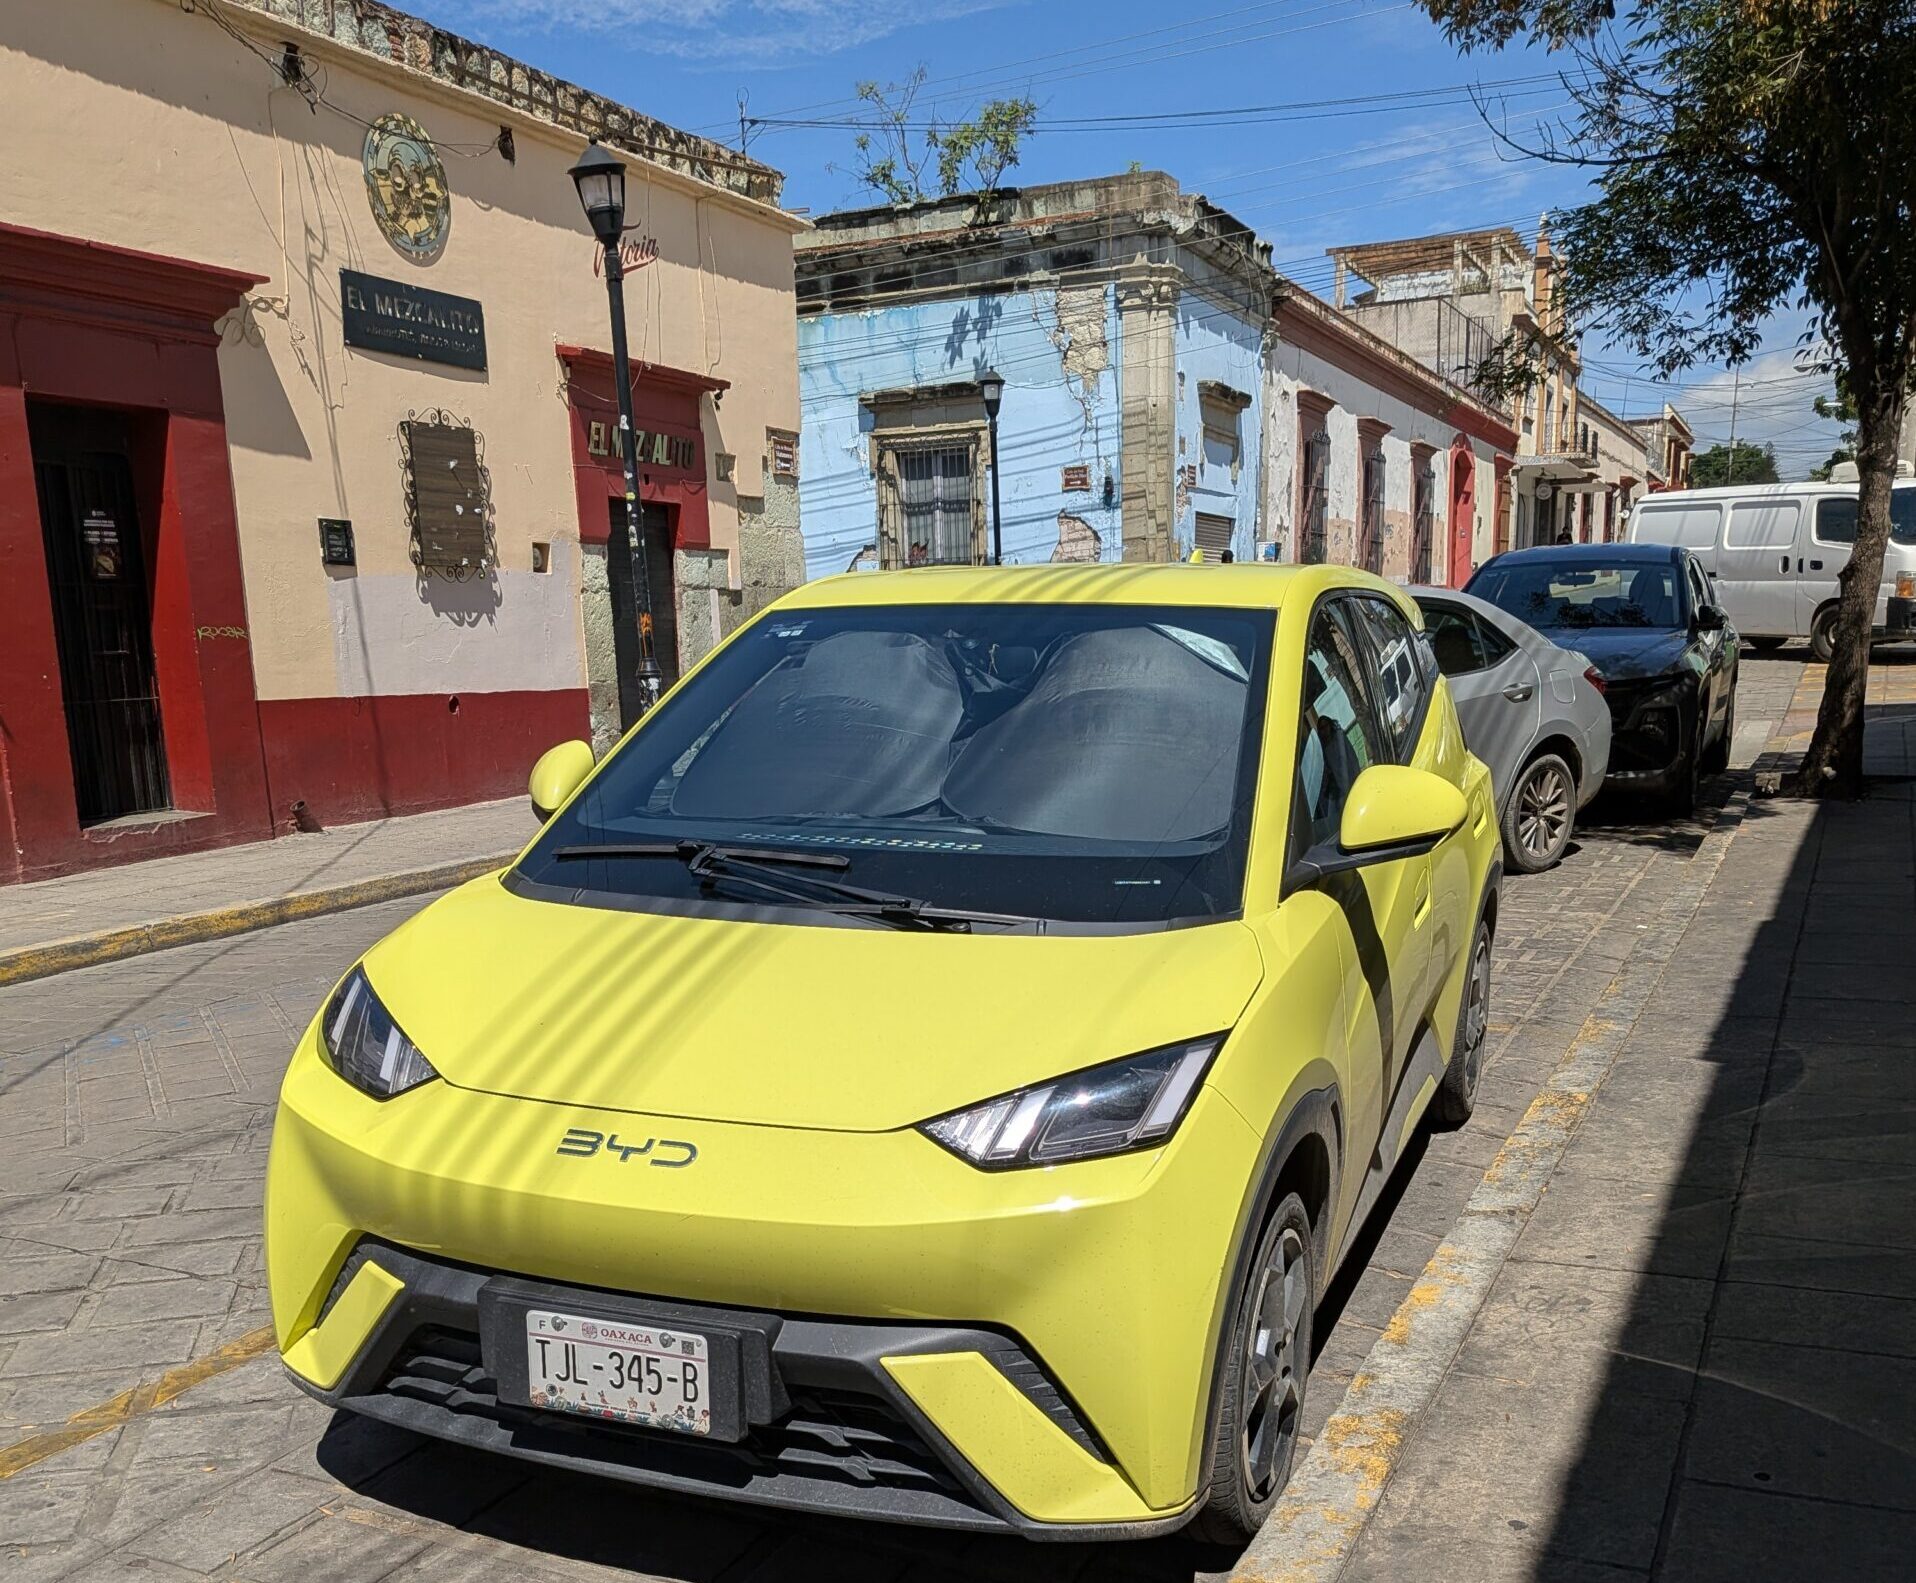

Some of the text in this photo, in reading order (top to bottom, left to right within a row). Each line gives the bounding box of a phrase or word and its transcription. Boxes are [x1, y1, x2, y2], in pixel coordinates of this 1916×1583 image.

[593, 218, 660, 278] Vtoria
[347, 285, 367, 311] EL
[375, 292, 480, 334] MEZCALITO
[589, 421, 695, 470] EL MZCALITO
[556, 1128, 698, 1168] BYD
[600, 1328, 652, 1344] OAXACA
[535, 1338, 699, 1403] TJL-345-B
